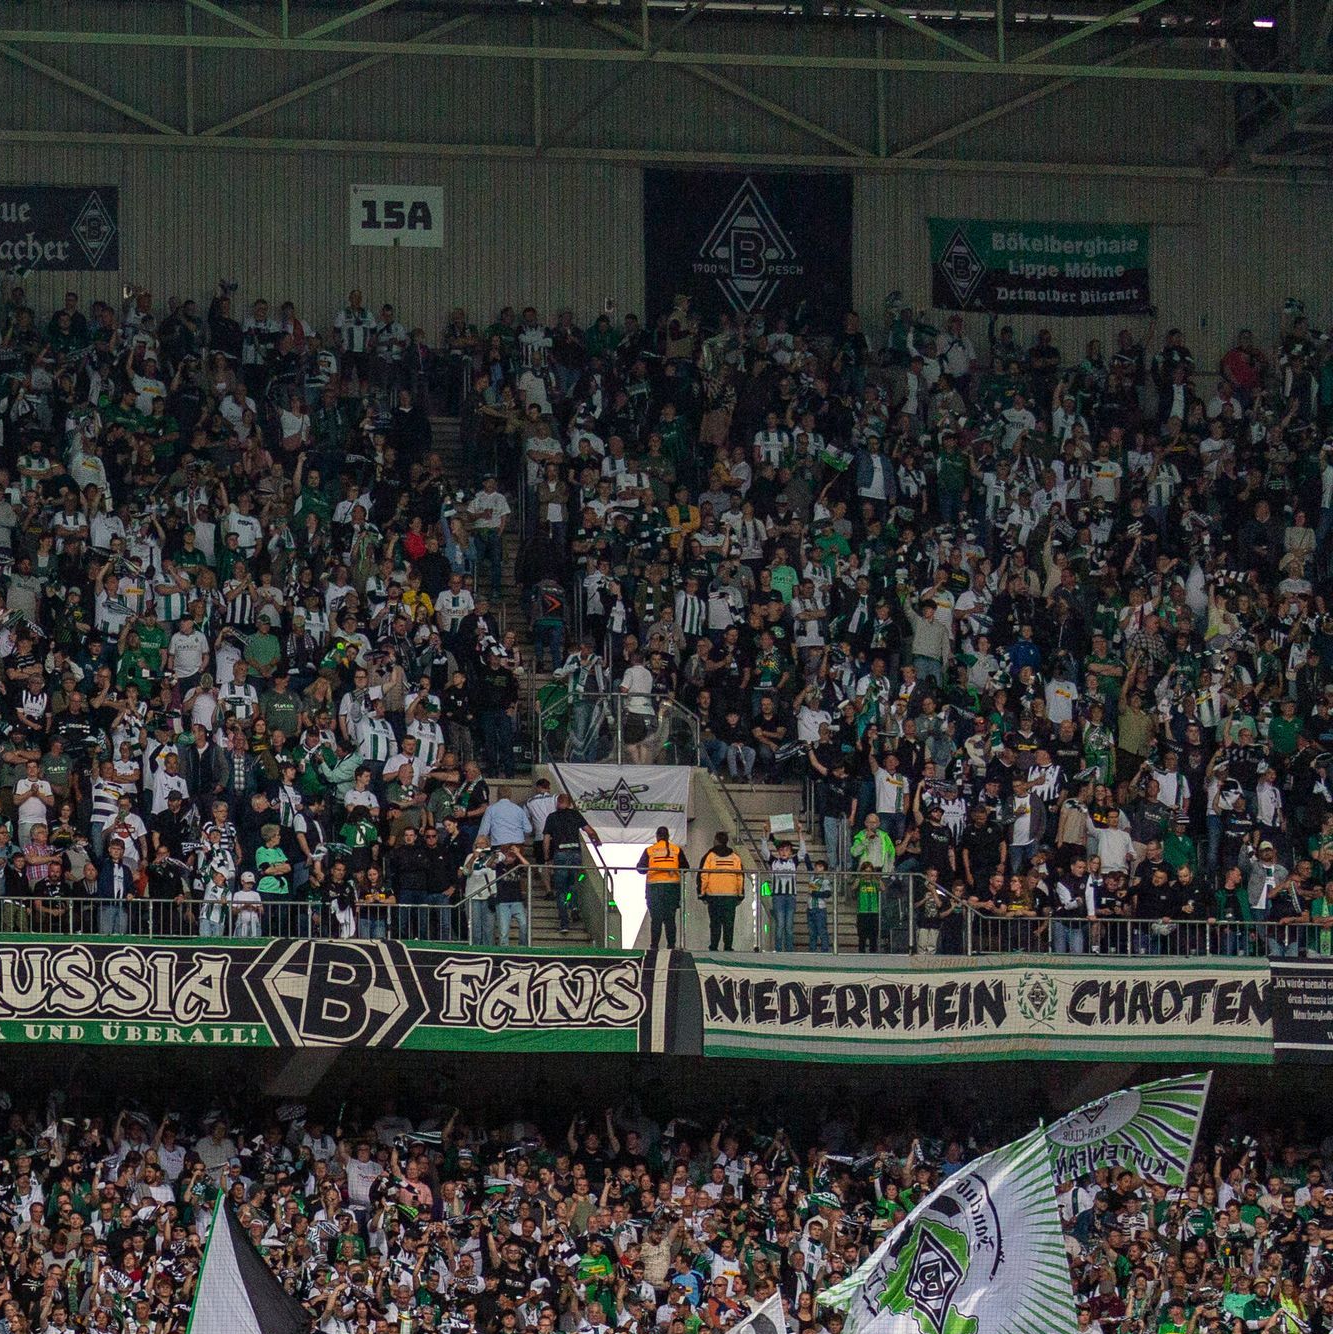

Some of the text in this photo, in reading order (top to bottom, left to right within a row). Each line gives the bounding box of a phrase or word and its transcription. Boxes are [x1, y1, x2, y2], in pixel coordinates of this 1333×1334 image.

[360, 200, 433, 231] 15A
[435, 956, 647, 1033] FANS
[703, 973, 1276, 1030] NIEDERRHEIN CHAOTEN
[24, 1023, 85, 1041] UND
[101, 1022, 258, 1045] ÜBERALL!
